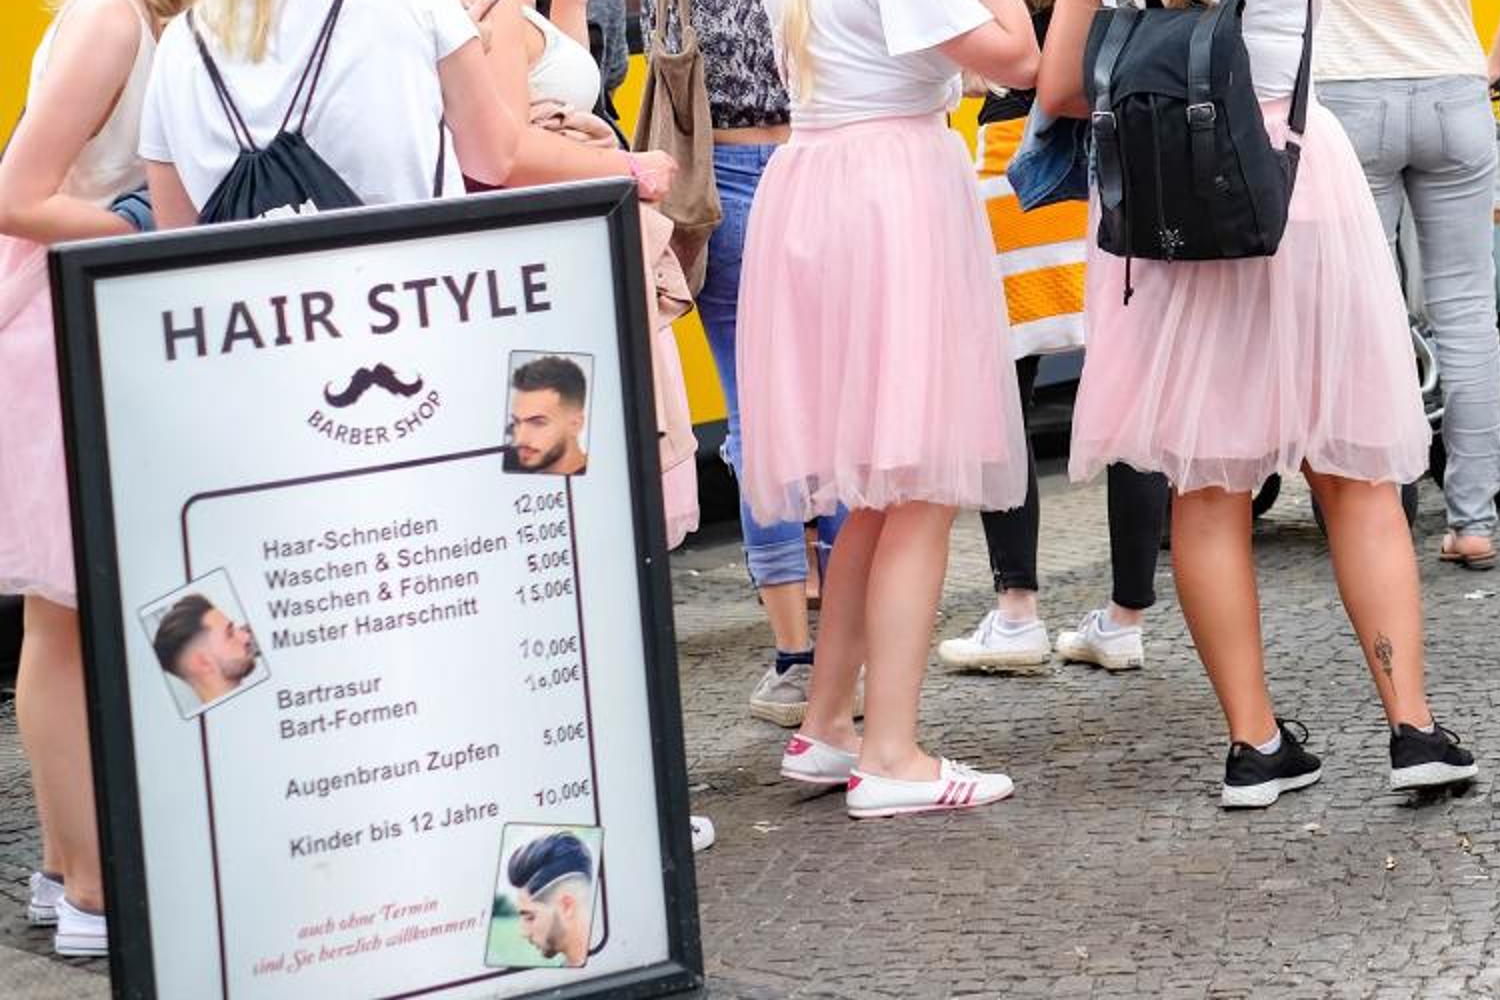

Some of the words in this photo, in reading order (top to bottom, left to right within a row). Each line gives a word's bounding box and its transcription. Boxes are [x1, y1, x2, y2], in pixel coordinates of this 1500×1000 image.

[162, 290, 342, 361] HAIR
[367, 263, 552, 335] STYLE
[307, 409, 391, 445] BARBER
[393, 389, 440, 439] SHOP
[263, 518, 439, 560] Haar-Schneiden
[513, 491, 566, 515] 12,00€
[265, 560, 368, 590] Waschen
[375, 551, 389, 572] &
[397, 534, 508, 569] Schneiden
[515, 520, 568, 545] 15,00€
[268, 590, 370, 620] Waschen
[377, 581, 393, 601] &
[400, 570, 480, 598] Föhnen
[526, 549, 571, 573] 5,00€
[272, 623, 349, 649] Muster
[355, 597, 479, 635] Haarschnitt
[515, 578, 574, 605] 15,00€
[276, 677, 383, 709] Bartrasur
[519, 635, 578, 659] 10,00€
[279, 700, 418, 740] Bart-Formen
[285, 758, 421, 799] Augenbraun
[426, 742, 501, 775] Zupfen
[543, 722, 586, 746] 5,00€
[289, 829, 363, 859] Kinder
[369, 819, 402, 842] bis
[409, 811, 434, 834] 12
[440, 801, 500, 828] Jahre
[533, 779, 591, 807] 10,00€
[297, 916, 336, 940] auch
[338, 910, 376, 932] ohne
[379, 896, 440, 923] Termin
[252, 953, 285, 976] sind
[285, 950, 316, 974] Sie
[318, 934, 383, 964] herzlich
